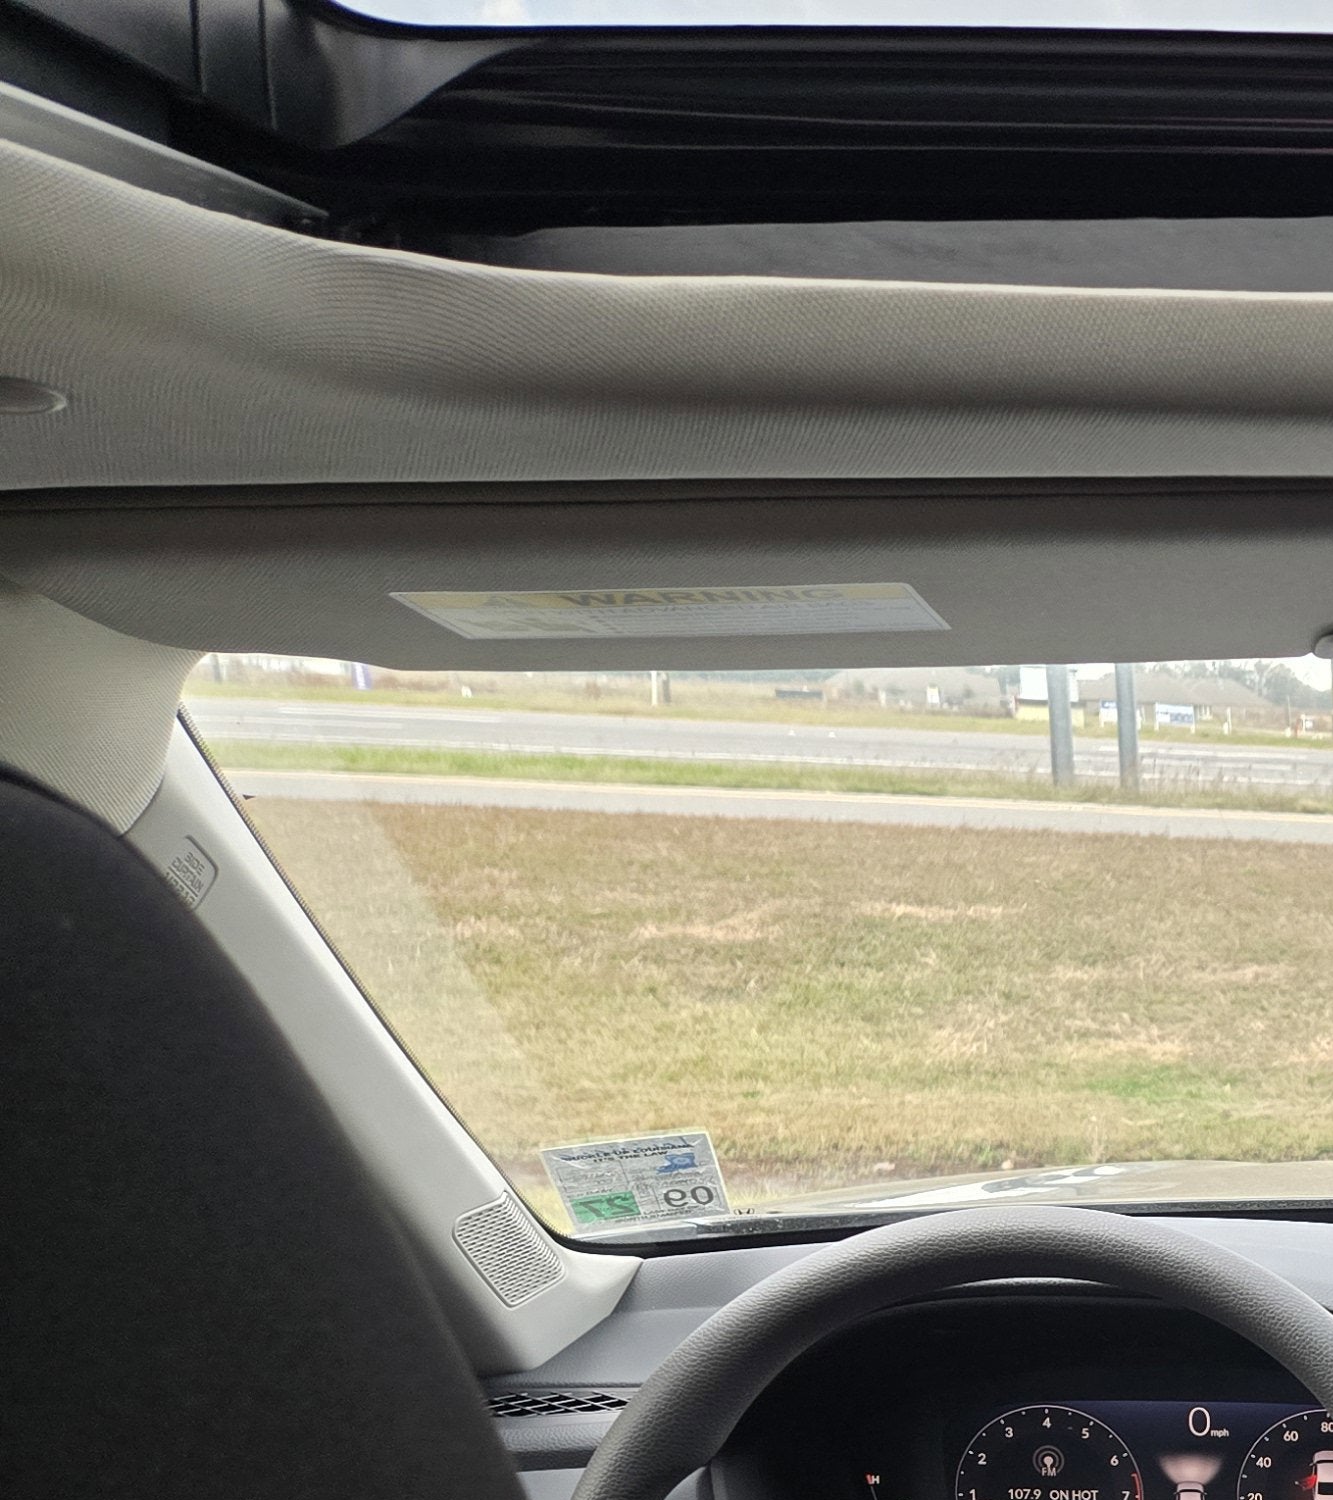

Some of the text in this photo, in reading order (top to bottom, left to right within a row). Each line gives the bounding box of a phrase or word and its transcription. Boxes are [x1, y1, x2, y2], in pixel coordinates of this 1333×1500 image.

[560, 589, 844, 606] WARNING
[1042, 1417, 1051, 1428] 4
[1188, 1407, 1229, 1440] 0 mph
[1005, 1427, 1014, 1438] 3
[1081, 1428, 1089, 1438] 5
[1283, 1431, 1299, 1442] 60
[977, 1453, 987, 1465] 2
[1110, 1455, 1119, 1466] 6
[1256, 1456, 1272, 1468] 40
[1042, 1467, 1057, 1477] FM
[969, 1489, 976, 1500] 1
[1008, 1488, 1099, 1500] 107.9 ON HOT
